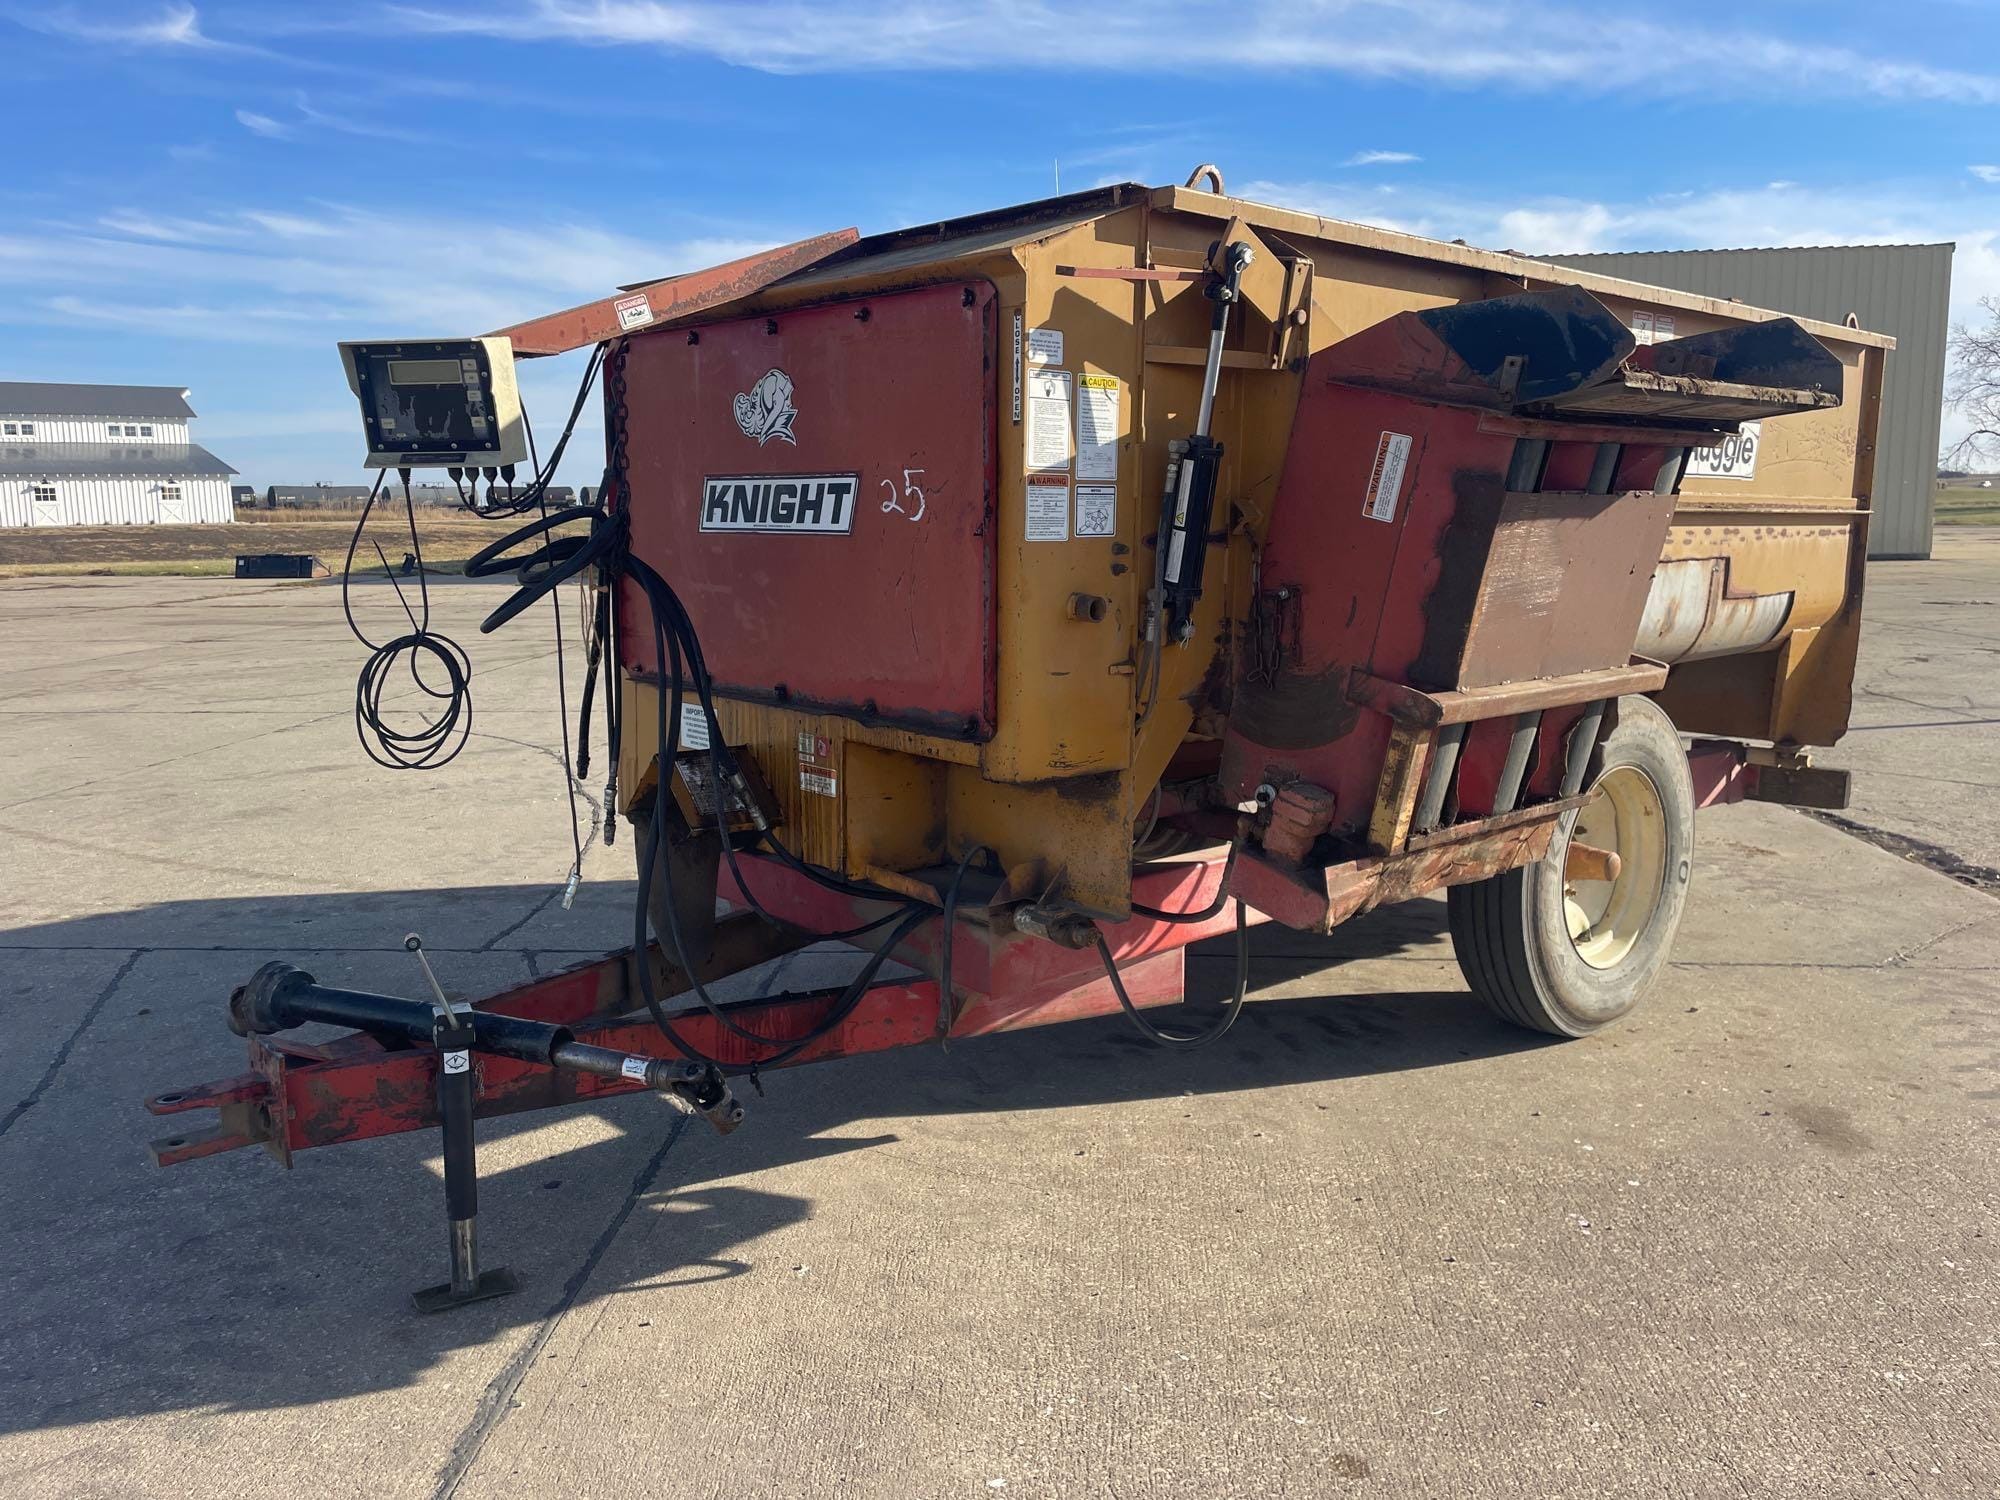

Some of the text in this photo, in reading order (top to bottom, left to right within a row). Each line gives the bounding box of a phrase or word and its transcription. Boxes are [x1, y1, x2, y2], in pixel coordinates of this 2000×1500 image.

[1088, 377, 1117, 388] CAUTION
[1036, 477, 1067, 486] WARNING
[1370, 440, 1389, 494] WARNING
[706, 482, 852, 525] KNIGHT
[880, 469, 925, 522] 25
